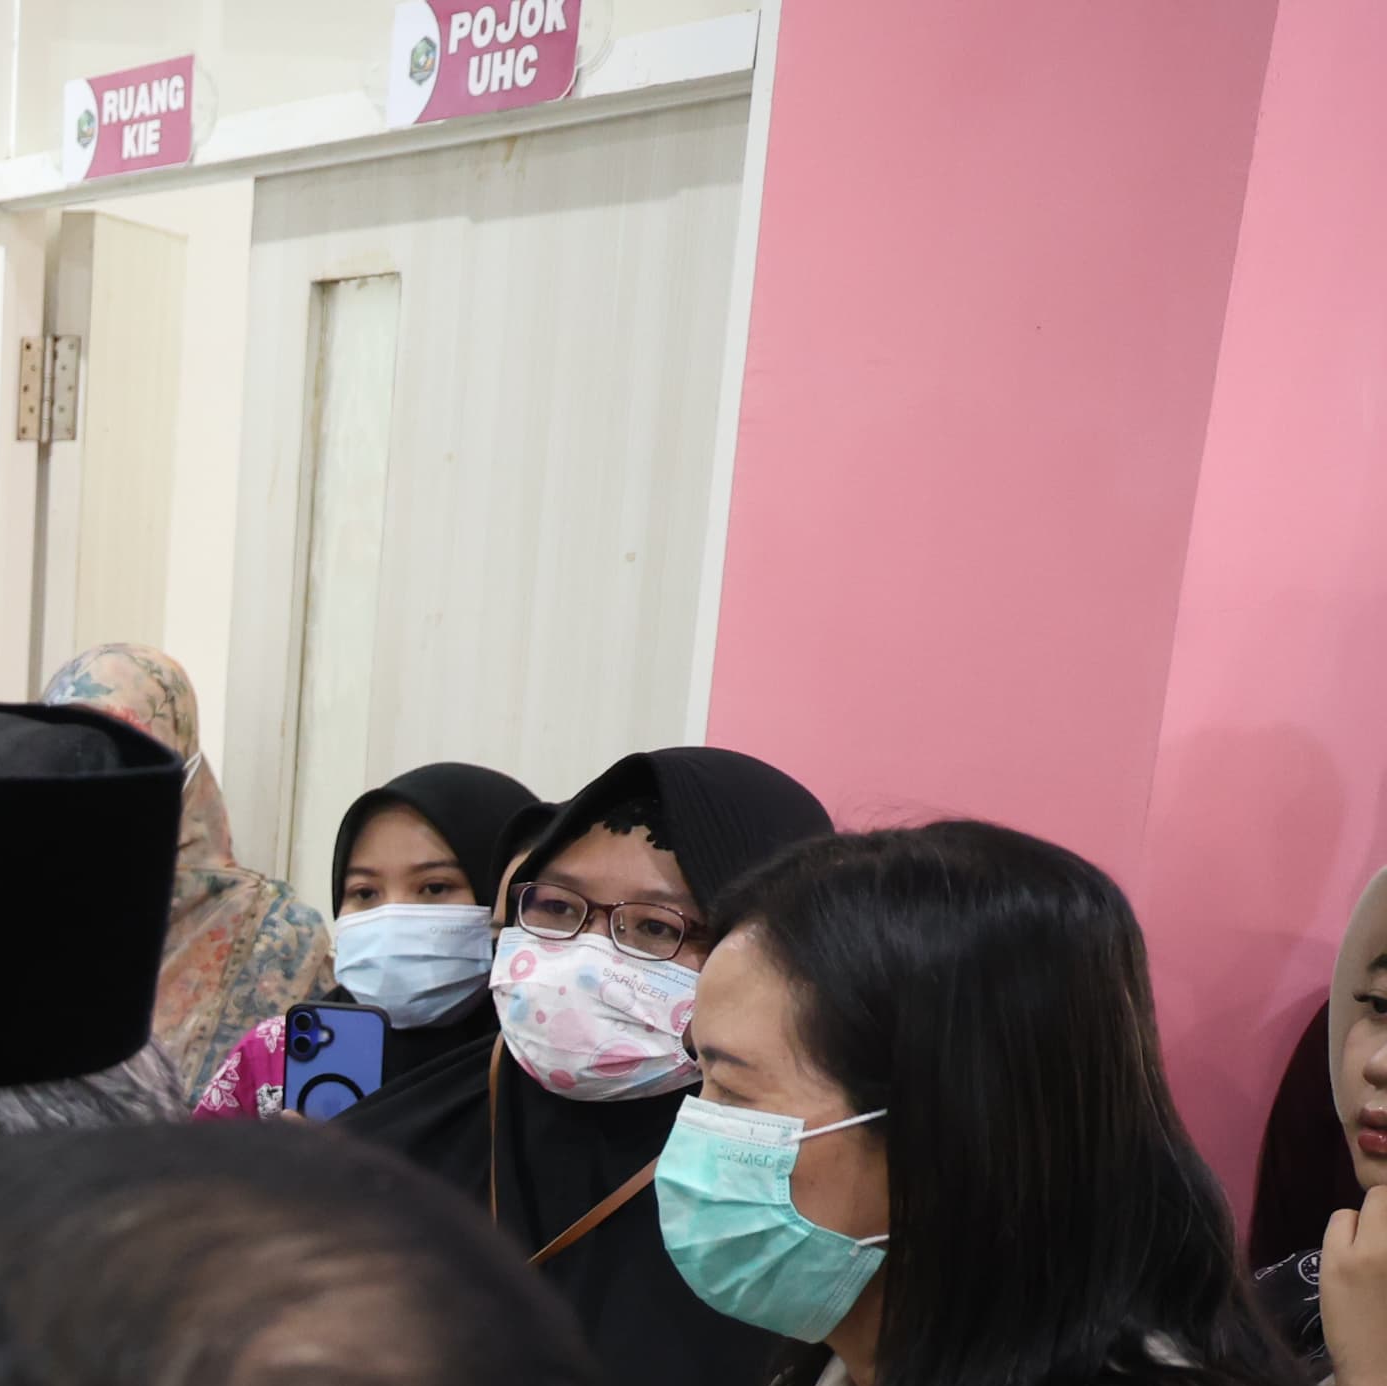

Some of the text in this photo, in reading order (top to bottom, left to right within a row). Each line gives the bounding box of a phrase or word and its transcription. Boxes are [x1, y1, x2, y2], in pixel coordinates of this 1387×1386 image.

[448, 0, 567, 55] POJOK
[468, 44, 538, 96] UHC
[102, 74, 185, 125] RUANG
[122, 119, 161, 159] KIE
